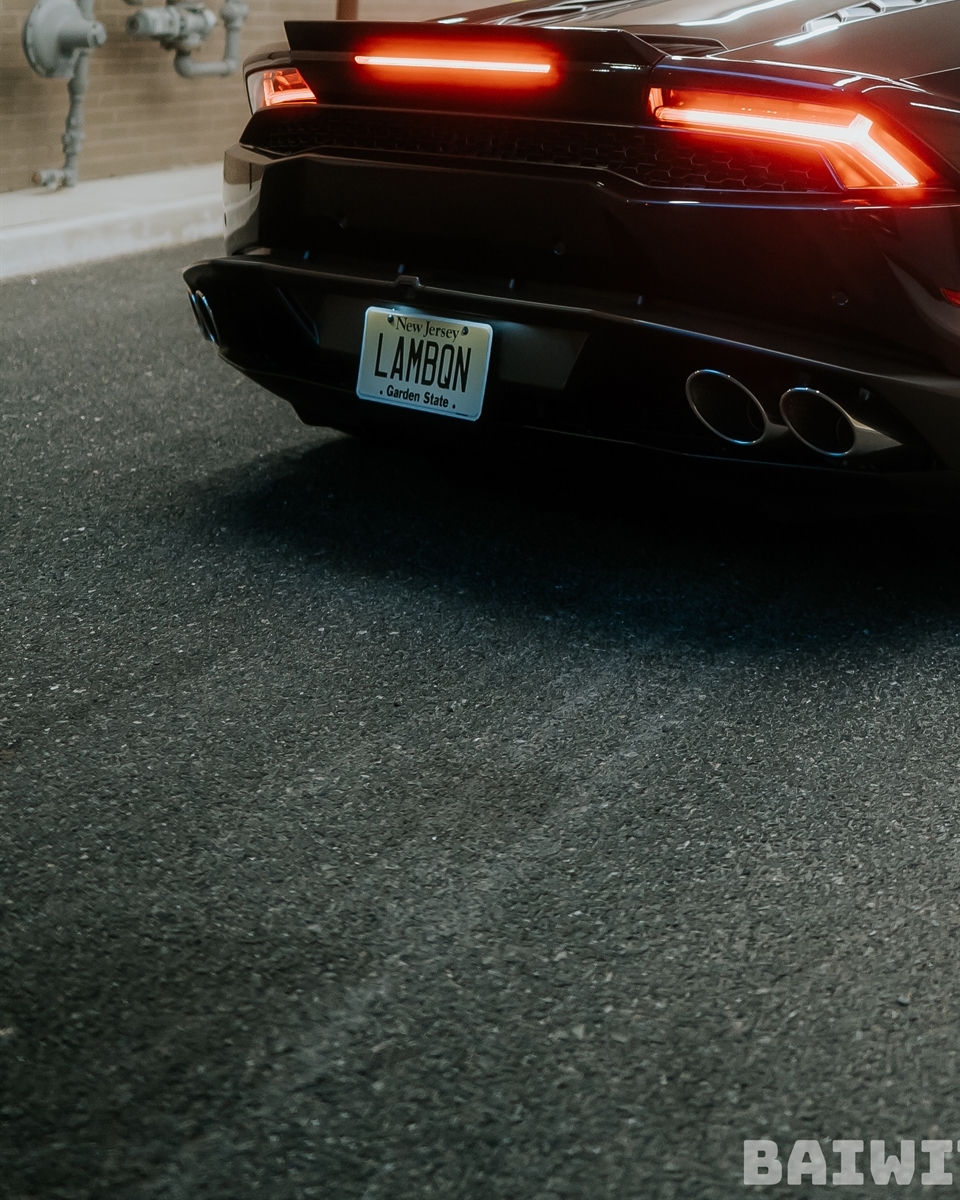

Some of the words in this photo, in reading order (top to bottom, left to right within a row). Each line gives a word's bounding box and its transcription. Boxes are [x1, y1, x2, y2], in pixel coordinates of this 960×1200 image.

[396, 317, 423, 333] New
[423, 321, 459, 342] Jersey
[374, 332, 472, 393] LAMBQN
[386, 384, 420, 402] Garden
[423, 391, 449, 408] State
